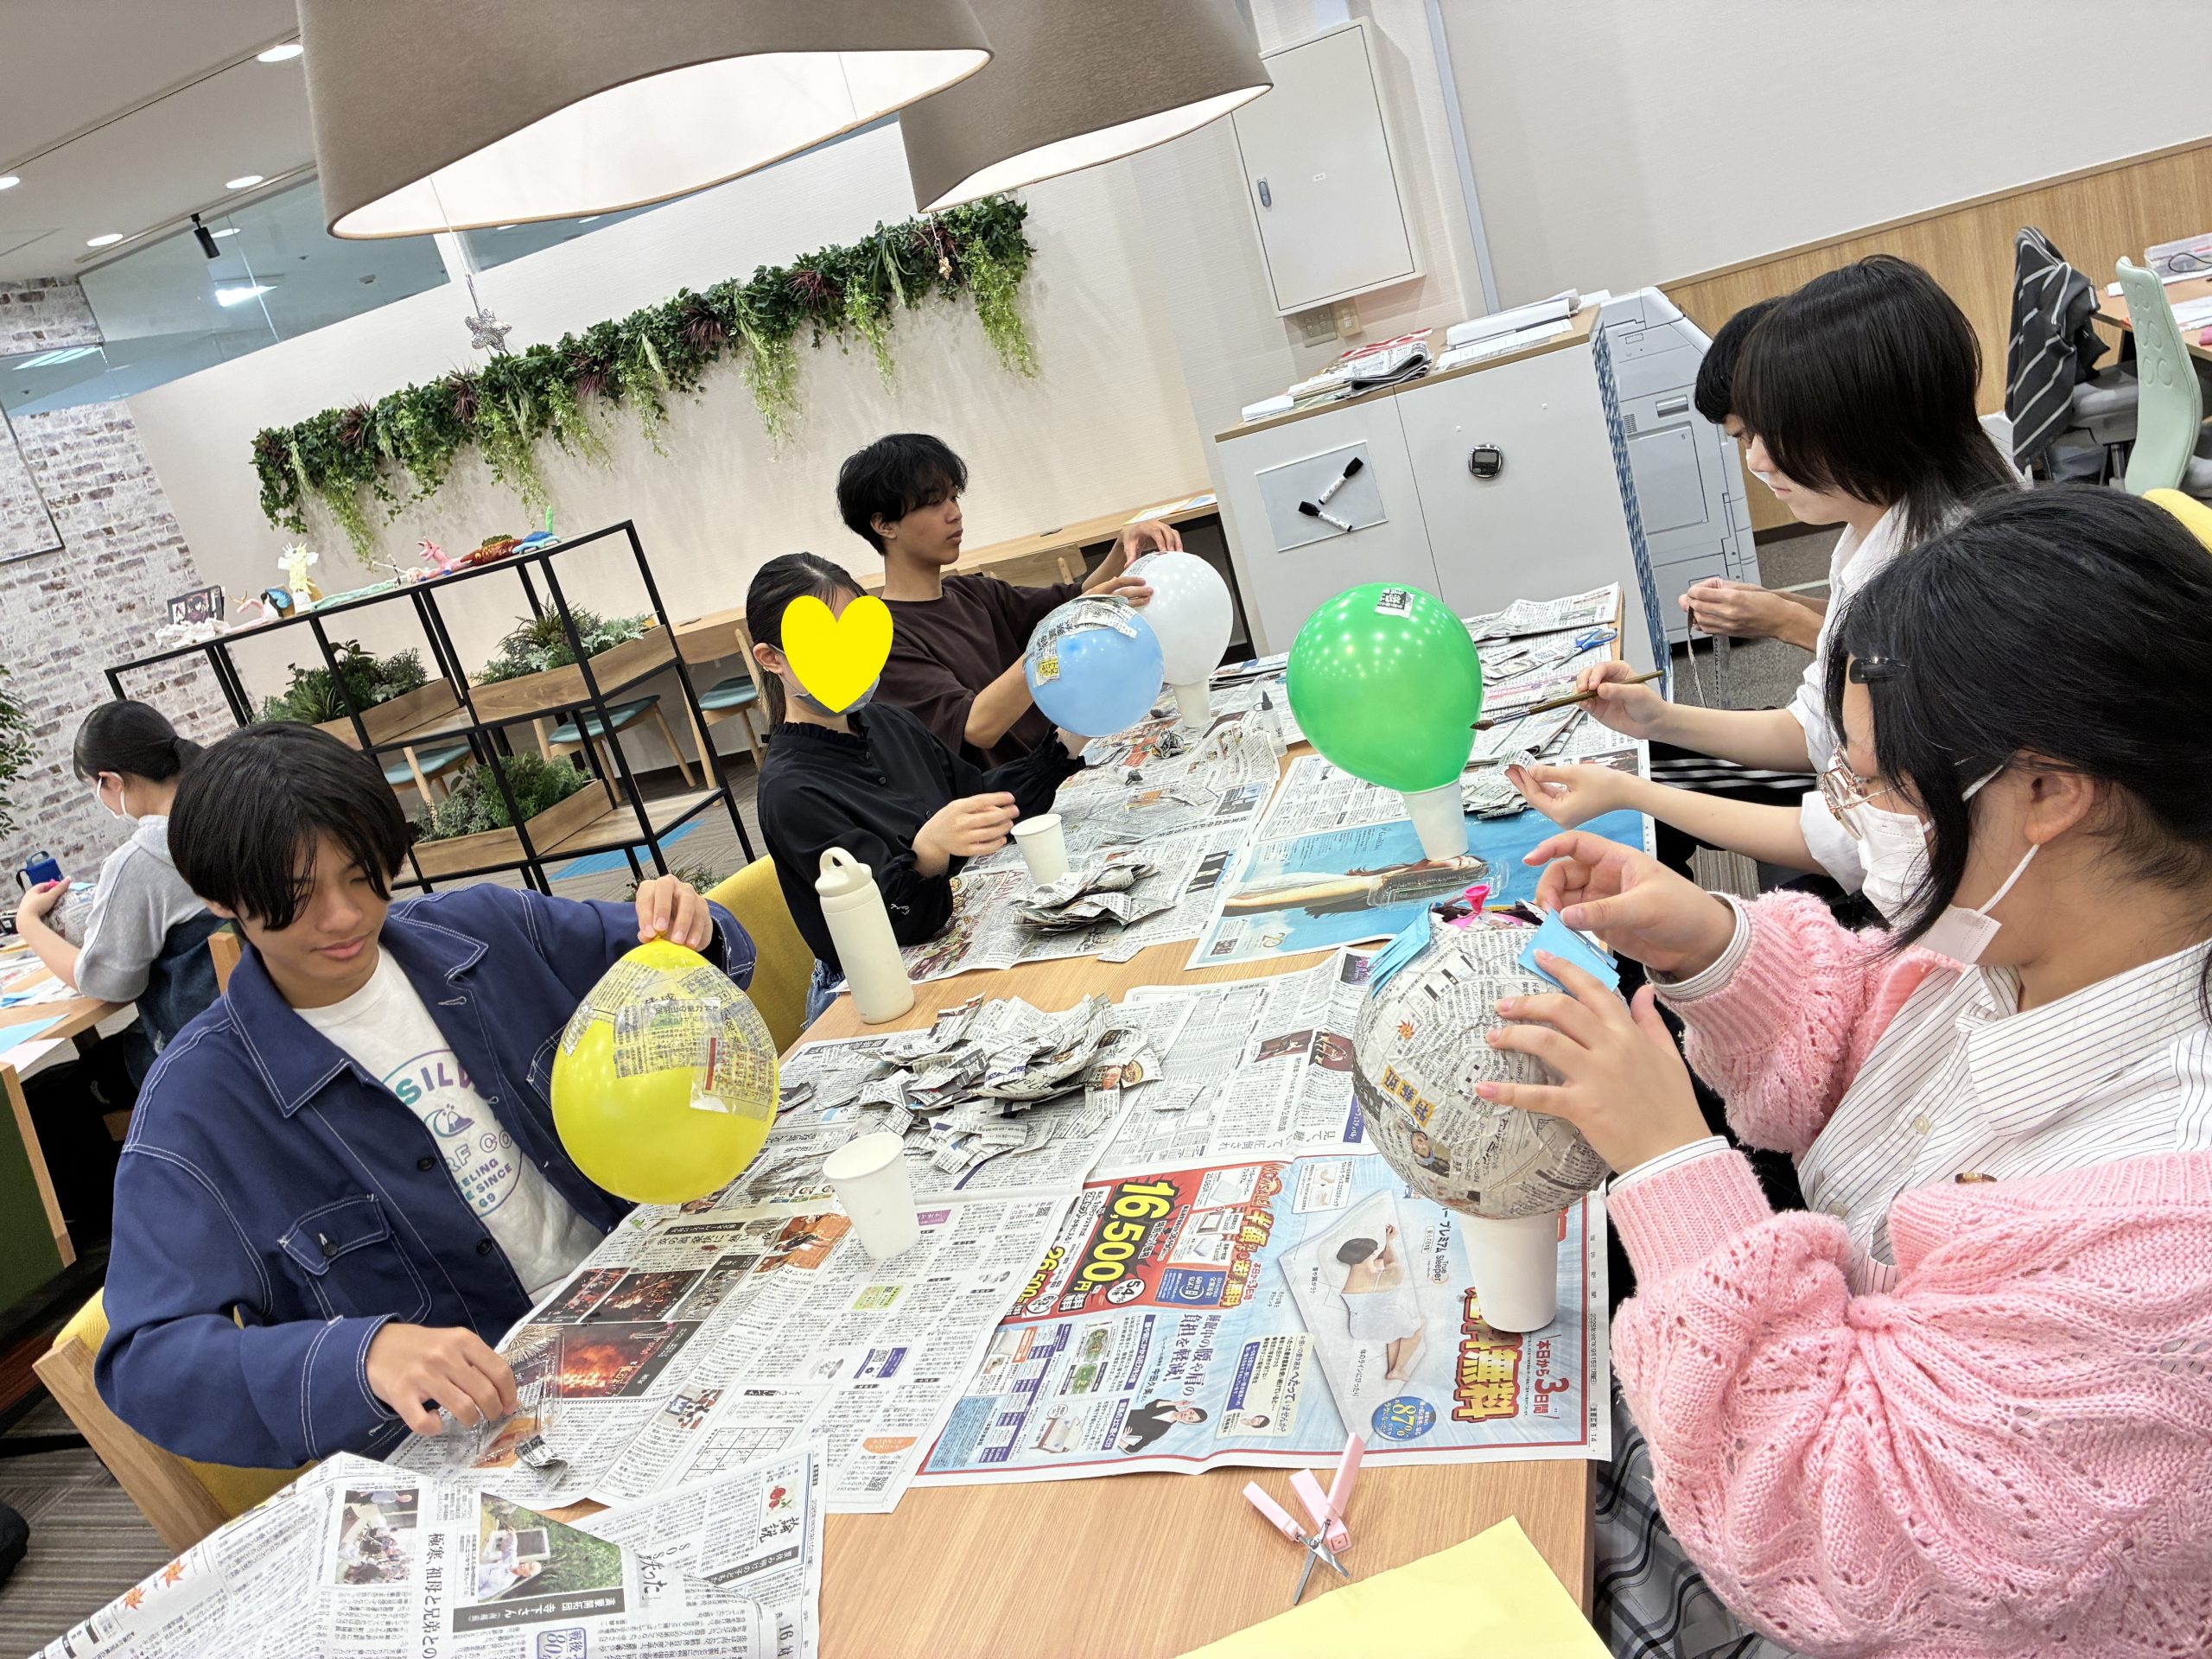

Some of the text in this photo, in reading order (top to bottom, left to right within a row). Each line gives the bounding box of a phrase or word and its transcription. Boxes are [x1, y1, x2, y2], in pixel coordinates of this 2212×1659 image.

[475, 1163, 513, 1194] SINCE
[1073, 1179, 1176, 1292] 16,500円
[1434, 1221, 1451, 1253] プレミアム
[1434, 1255, 1443, 1281] Sleeper
[1161, 1313, 1202, 1383] 負担を軽減!
[1182, 1314, 1221, 1396] 睡眠中の腰や肩の
[1533, 1340, 1570, 1414] 本日から3日間
[1390, 1403, 1416, 1436] 87%
[543, 1634, 567, 1654] 80
[779, 1623, 794, 1641] 16
